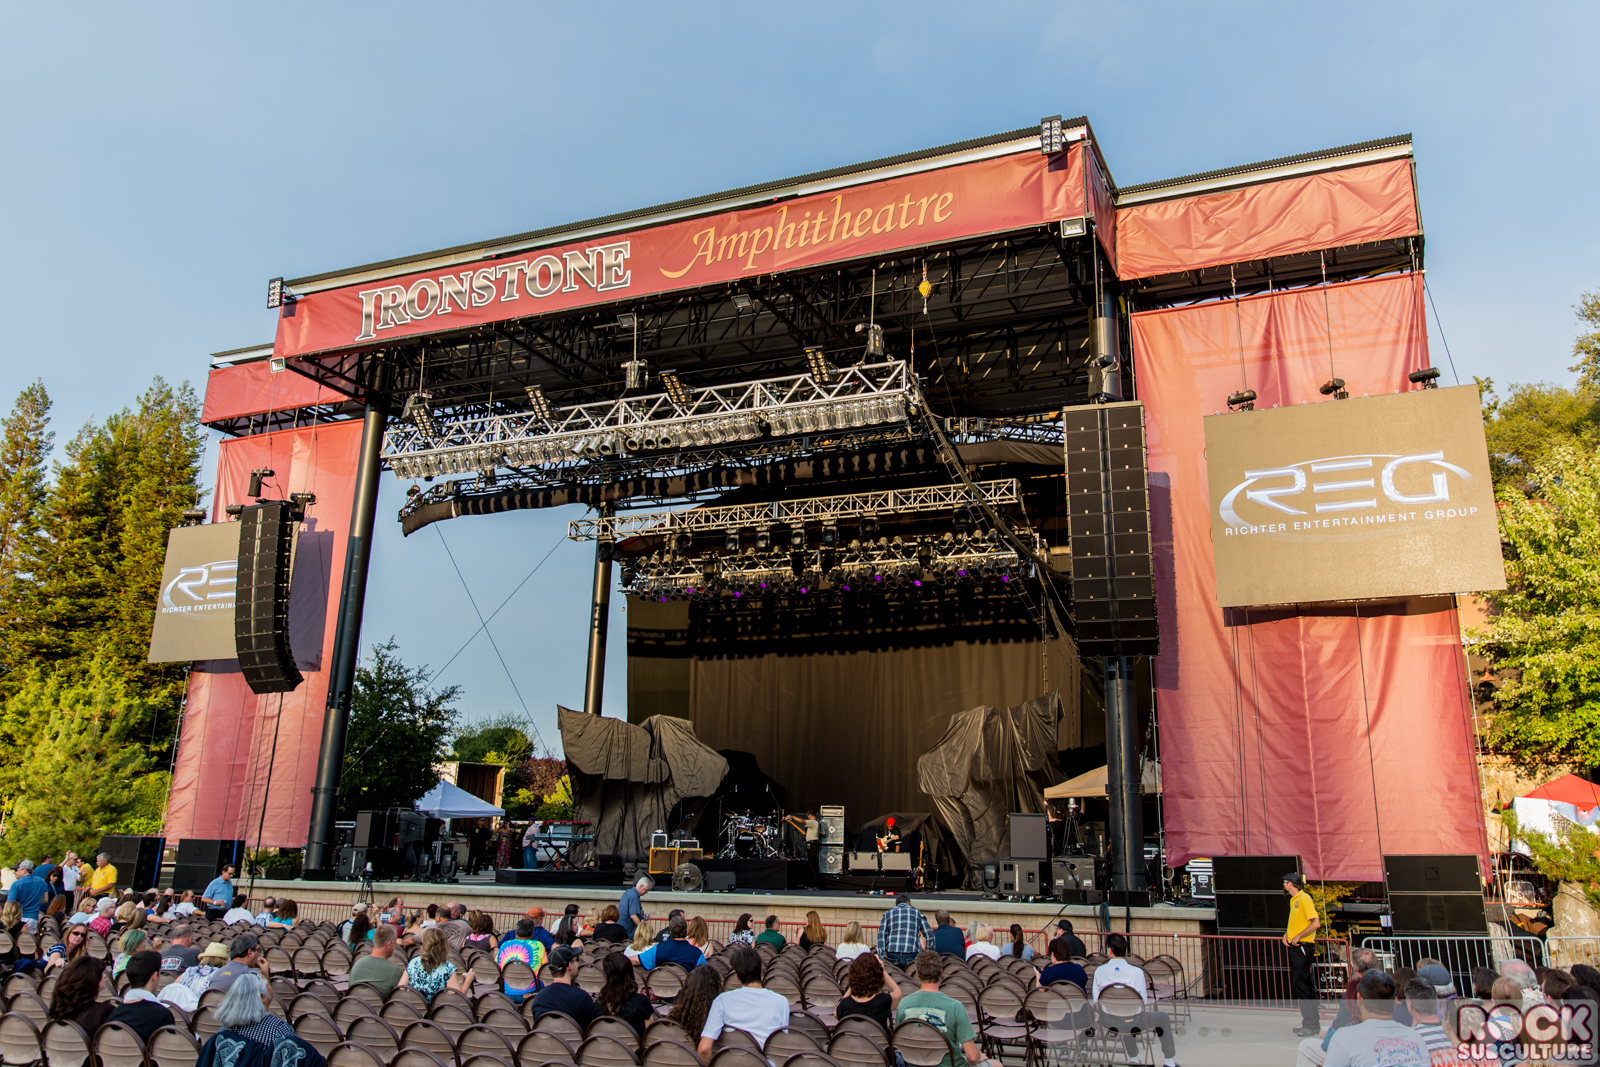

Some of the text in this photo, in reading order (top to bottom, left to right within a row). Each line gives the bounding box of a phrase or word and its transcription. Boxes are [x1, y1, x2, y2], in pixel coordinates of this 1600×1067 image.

[355, 190, 955, 342] IRONSTONE Amphitheatre
[1245, 450, 1450, 515] REG
[1225, 506, 1479, 536] RICHTER ENTERTAINMENT GROUP
[178, 563, 237, 600] RE
[161, 602, 236, 613] RICHTER ENTERTAIN
